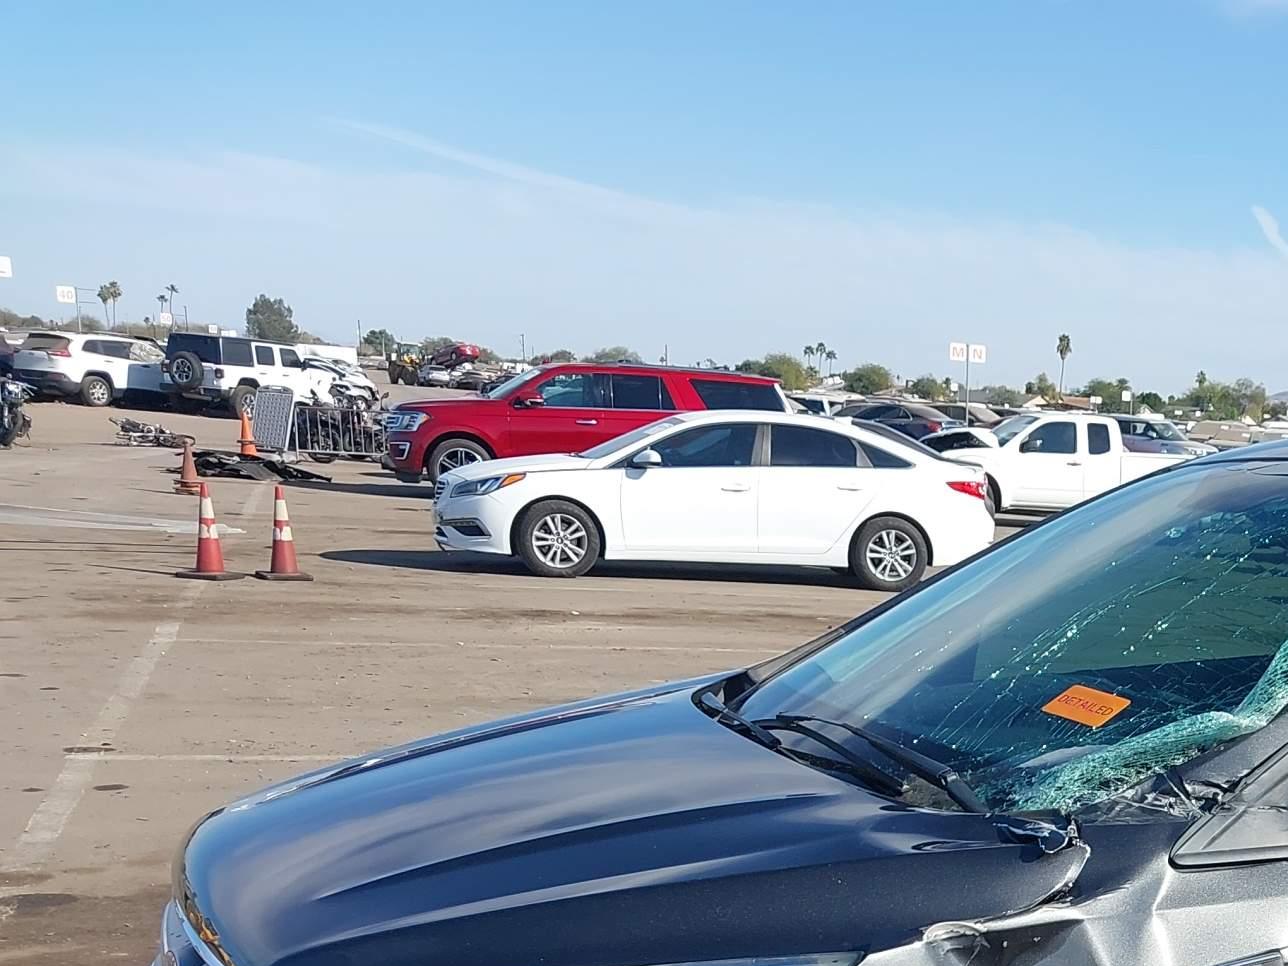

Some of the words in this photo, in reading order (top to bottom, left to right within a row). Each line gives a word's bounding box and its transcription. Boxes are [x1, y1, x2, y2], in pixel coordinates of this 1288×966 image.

[58, 289, 74, 301] 40
[952, 346, 964, 358] M
[973, 348, 983, 360] N
[1057, 694, 1114, 716] DETAILED
